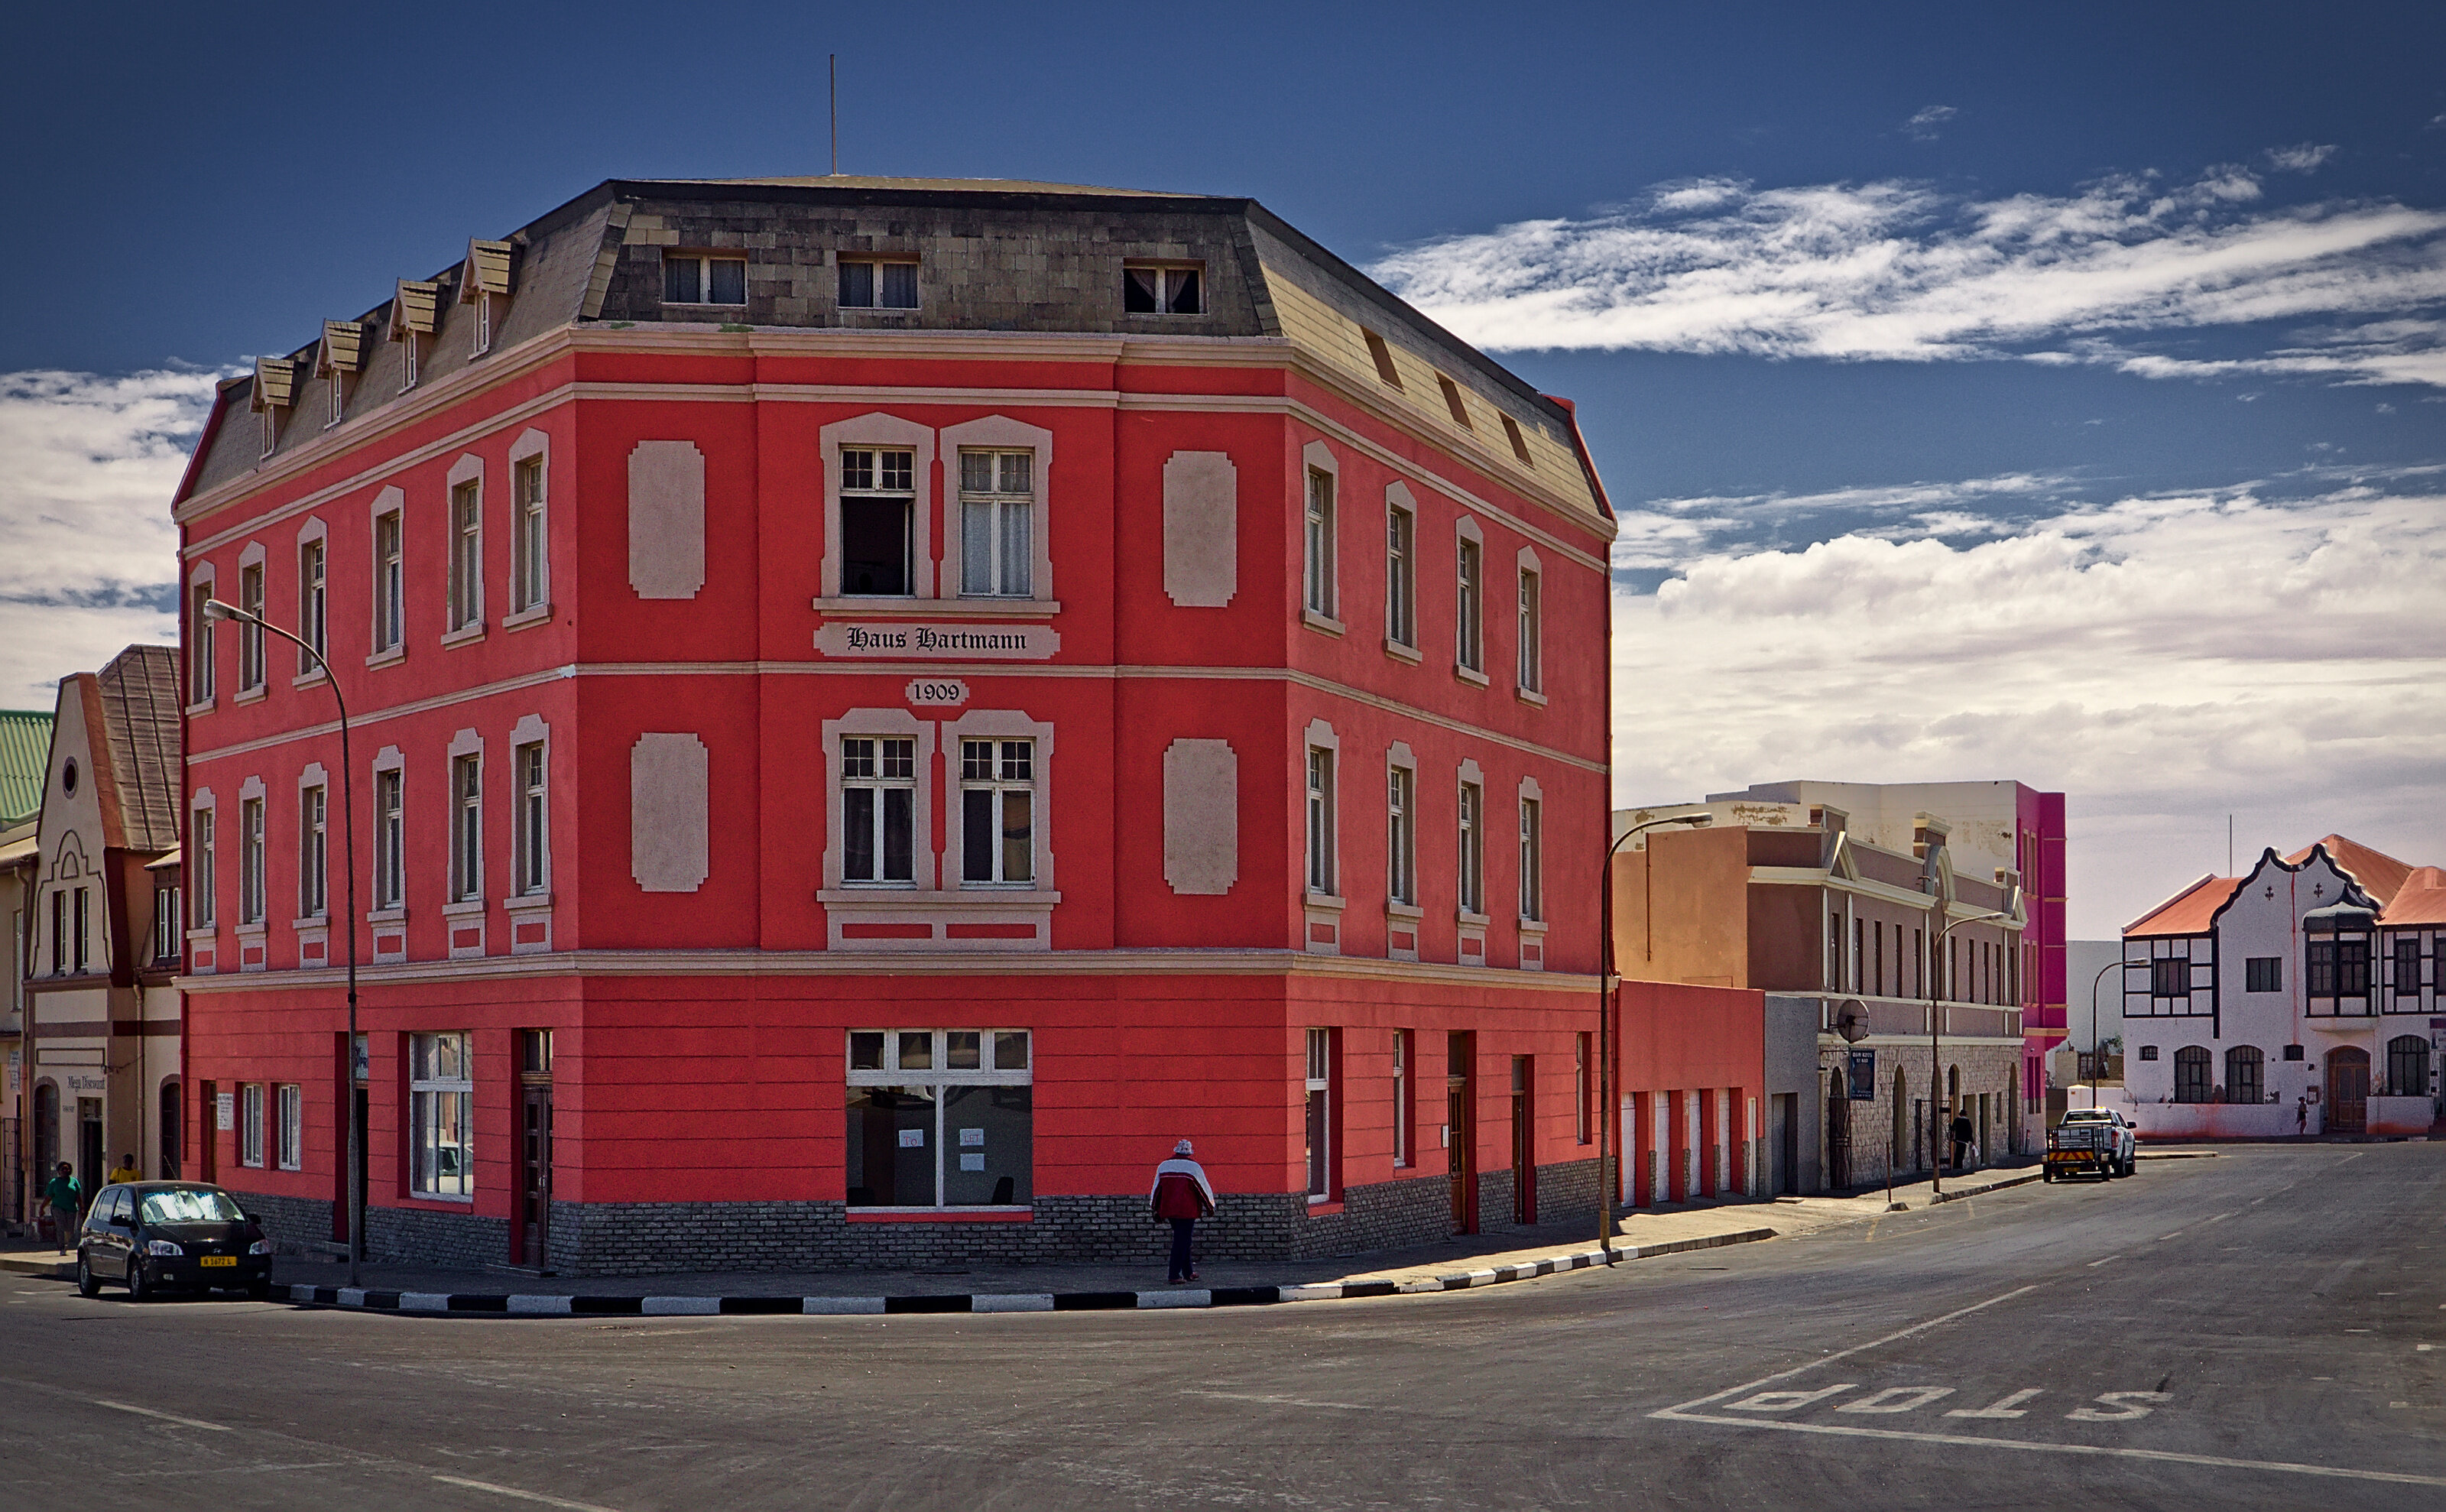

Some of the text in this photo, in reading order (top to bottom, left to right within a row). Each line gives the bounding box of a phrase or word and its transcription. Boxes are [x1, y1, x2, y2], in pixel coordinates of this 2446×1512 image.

[847, 627, 1027, 652] Haus Hartmann
[913, 683, 960, 701] 1909
[67, 1076, 105, 1092] Mega Discount
[964, 1134, 980, 1144] LET
[1721, 1384, 2175, 1422] STOP
